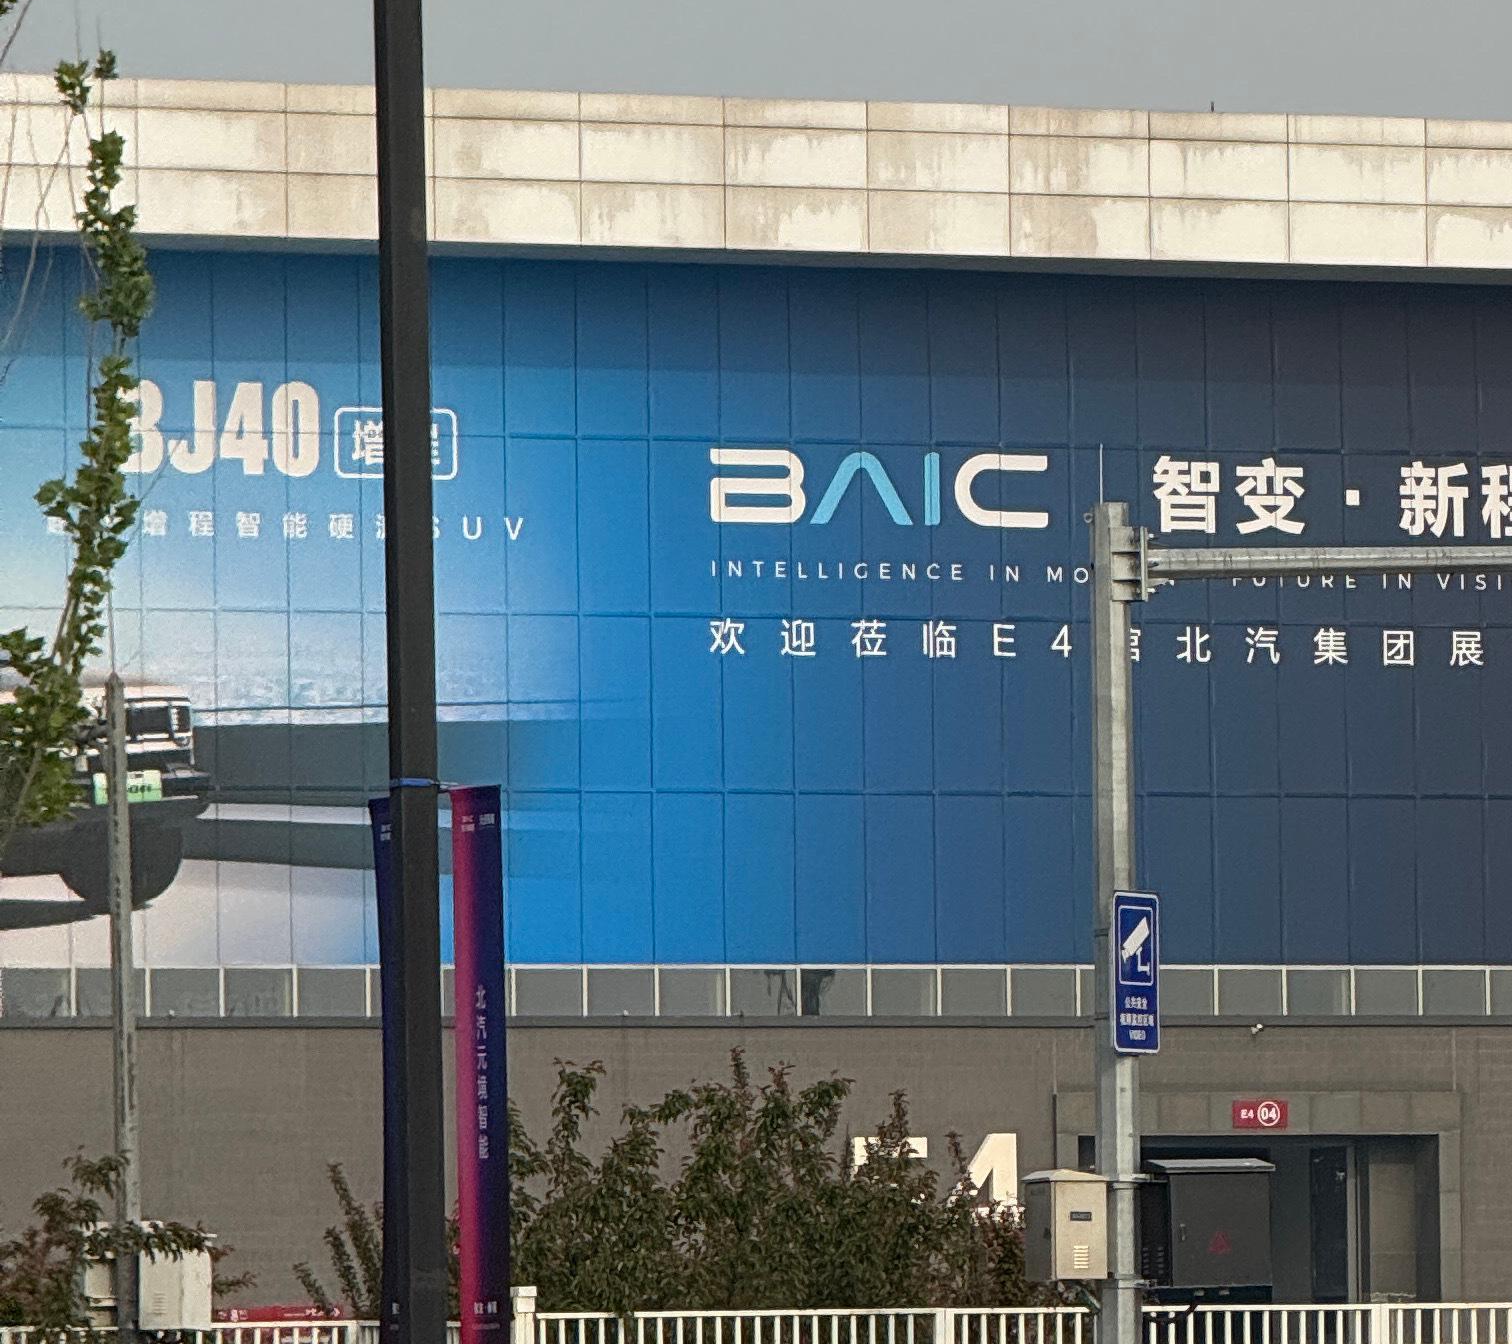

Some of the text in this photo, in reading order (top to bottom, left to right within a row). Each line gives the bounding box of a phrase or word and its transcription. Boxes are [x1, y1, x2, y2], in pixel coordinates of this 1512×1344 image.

[117, 379, 320, 477] BJ40
[351, 420, 441, 466] 增
[708, 447, 1049, 529] BAIC
[710, 560, 965, 581] INTELLIGENCE
[989, 562, 1021, 582] IN
[1382, 573, 1412, 590] IN
[1240, 1107, 1277, 1121] E4 04
